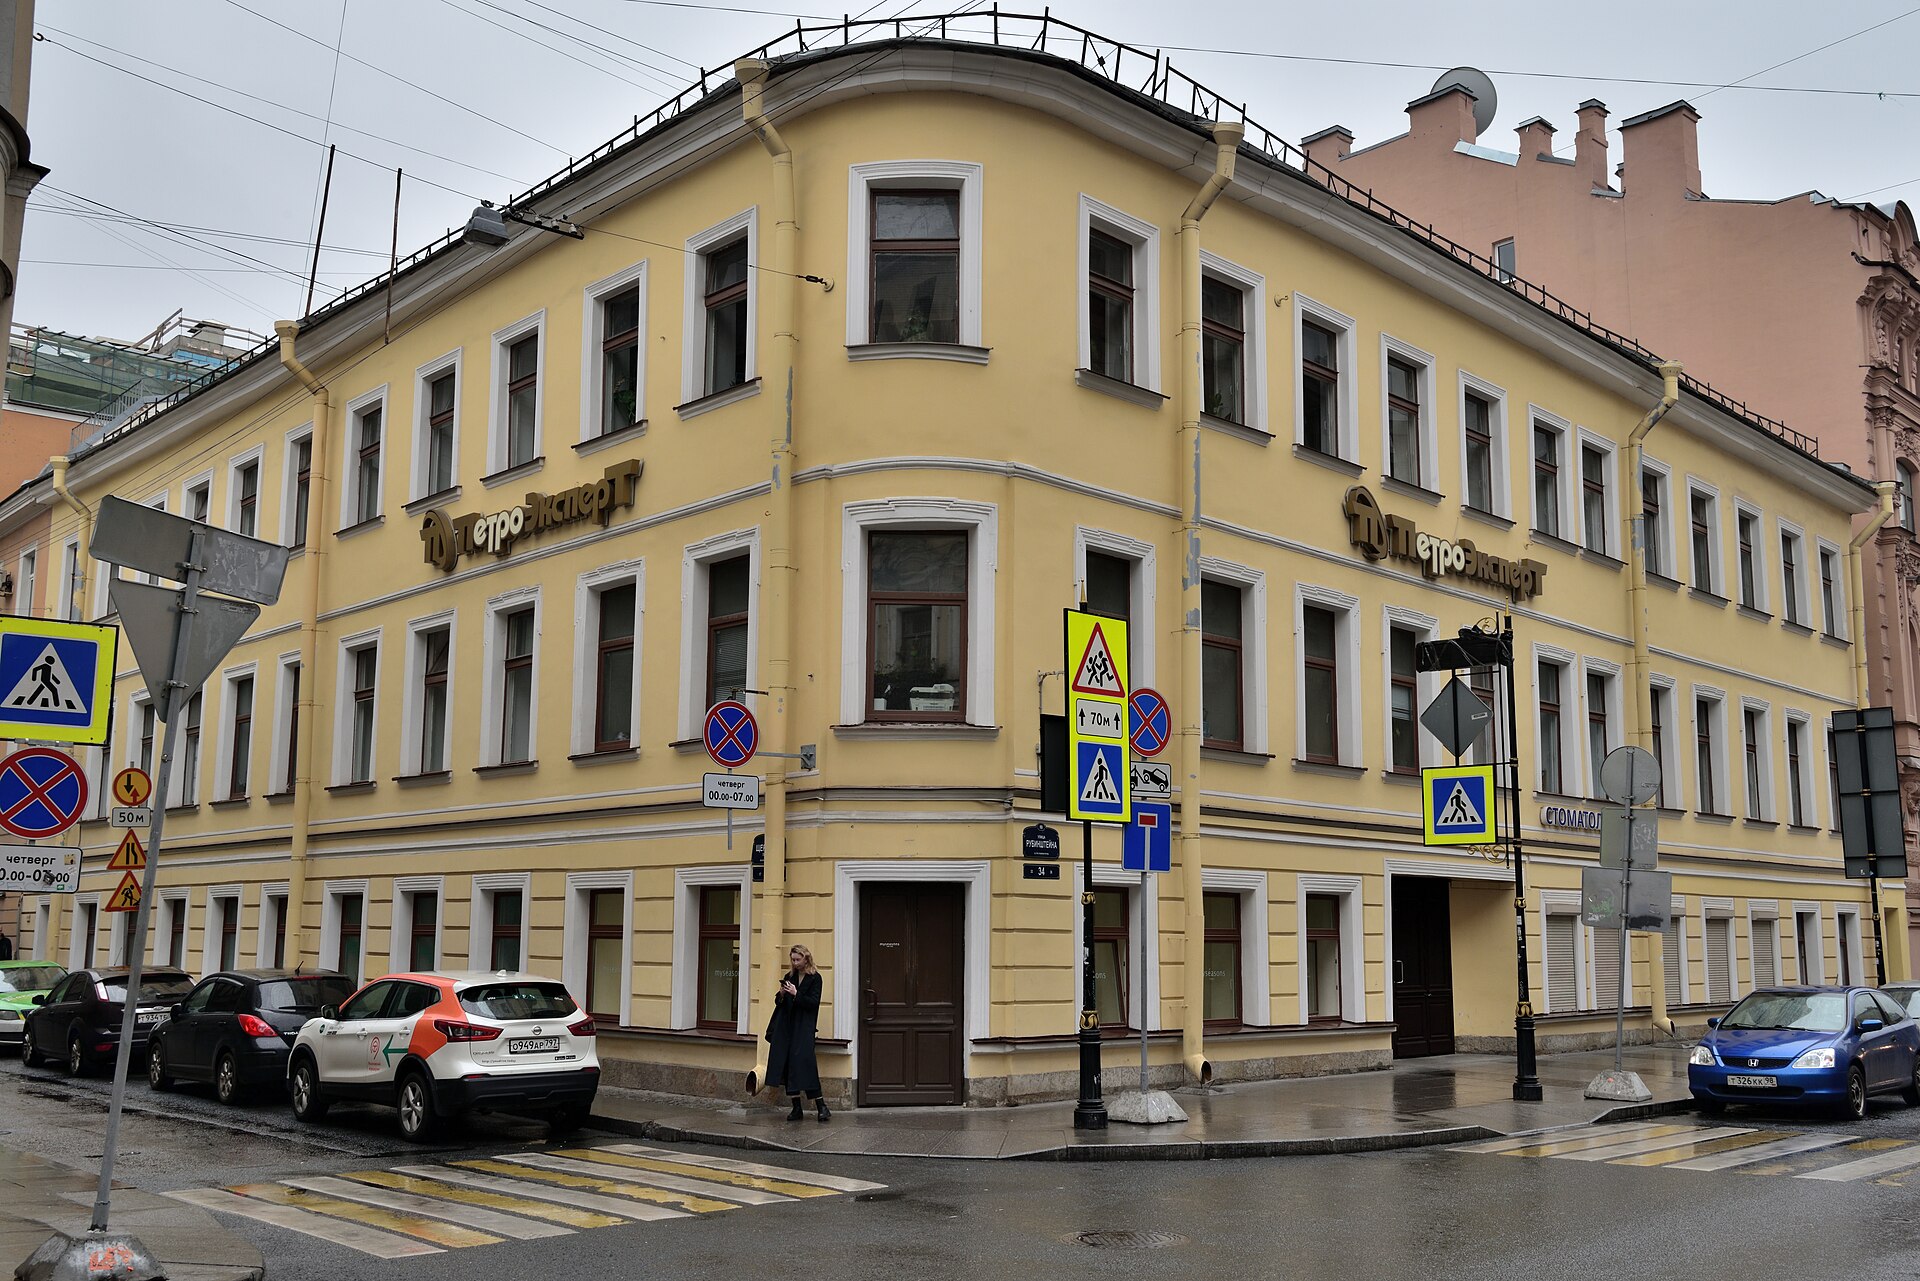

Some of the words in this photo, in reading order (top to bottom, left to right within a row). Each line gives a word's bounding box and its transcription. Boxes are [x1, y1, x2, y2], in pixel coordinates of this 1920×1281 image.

[717, 781, 745, 789] четверг
[709, 791, 753, 802] 00.00-07.00
[1026, 840, 1057, 849] РУБИНШТЕЙНА
[6, 855, 56, 867] четверг
[1038, 867, 1045, 876] 34
